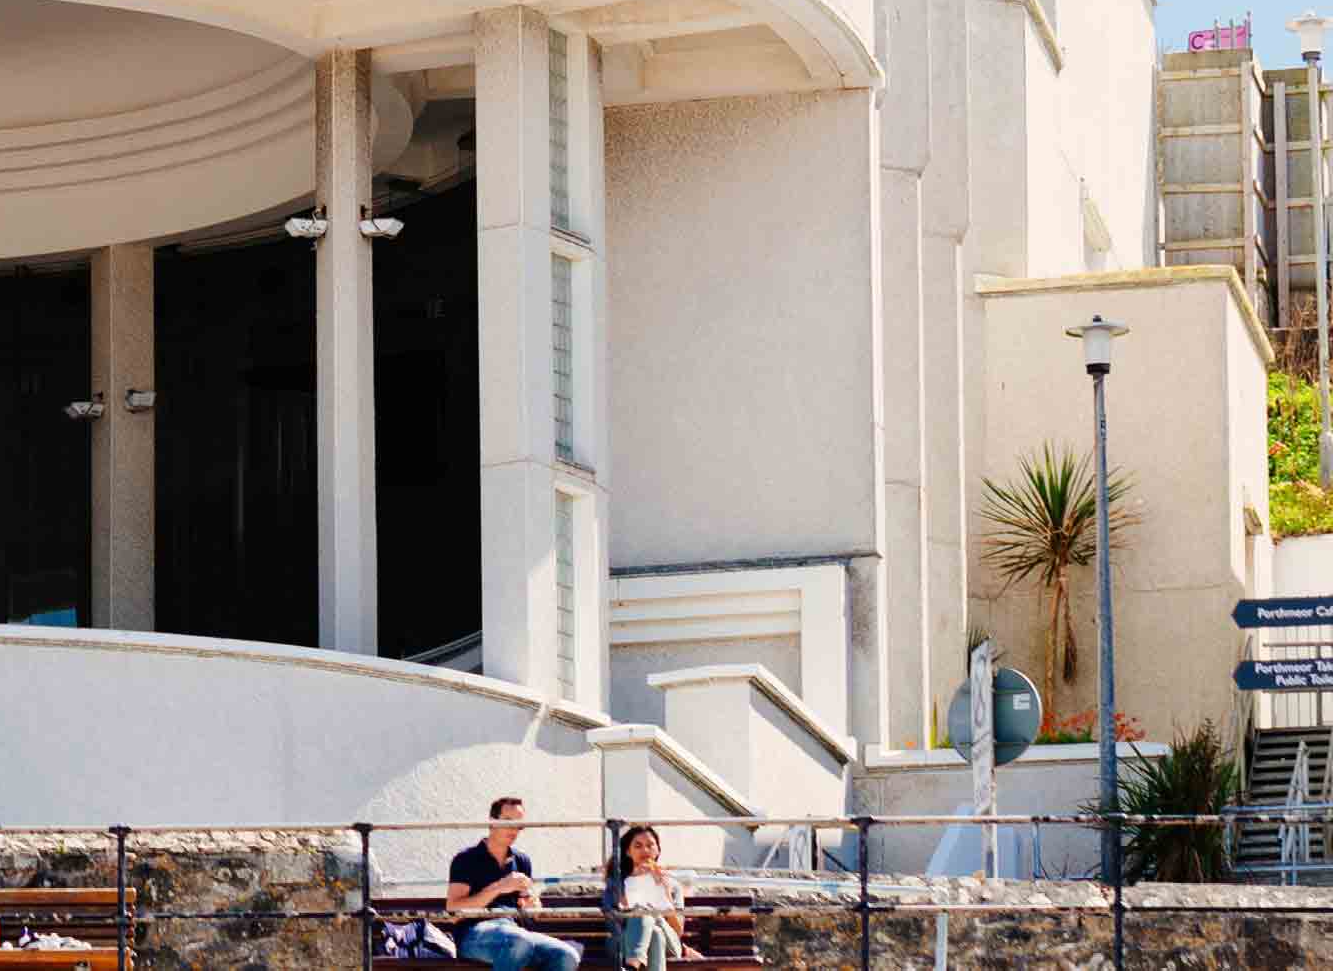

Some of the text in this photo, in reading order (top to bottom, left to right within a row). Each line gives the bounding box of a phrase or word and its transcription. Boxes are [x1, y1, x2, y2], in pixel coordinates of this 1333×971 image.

[1257, 606, 1313, 619] Porthmeor
[1255, 661, 1313, 674] Porthmeor
[1275, 674, 1307, 686] Public
